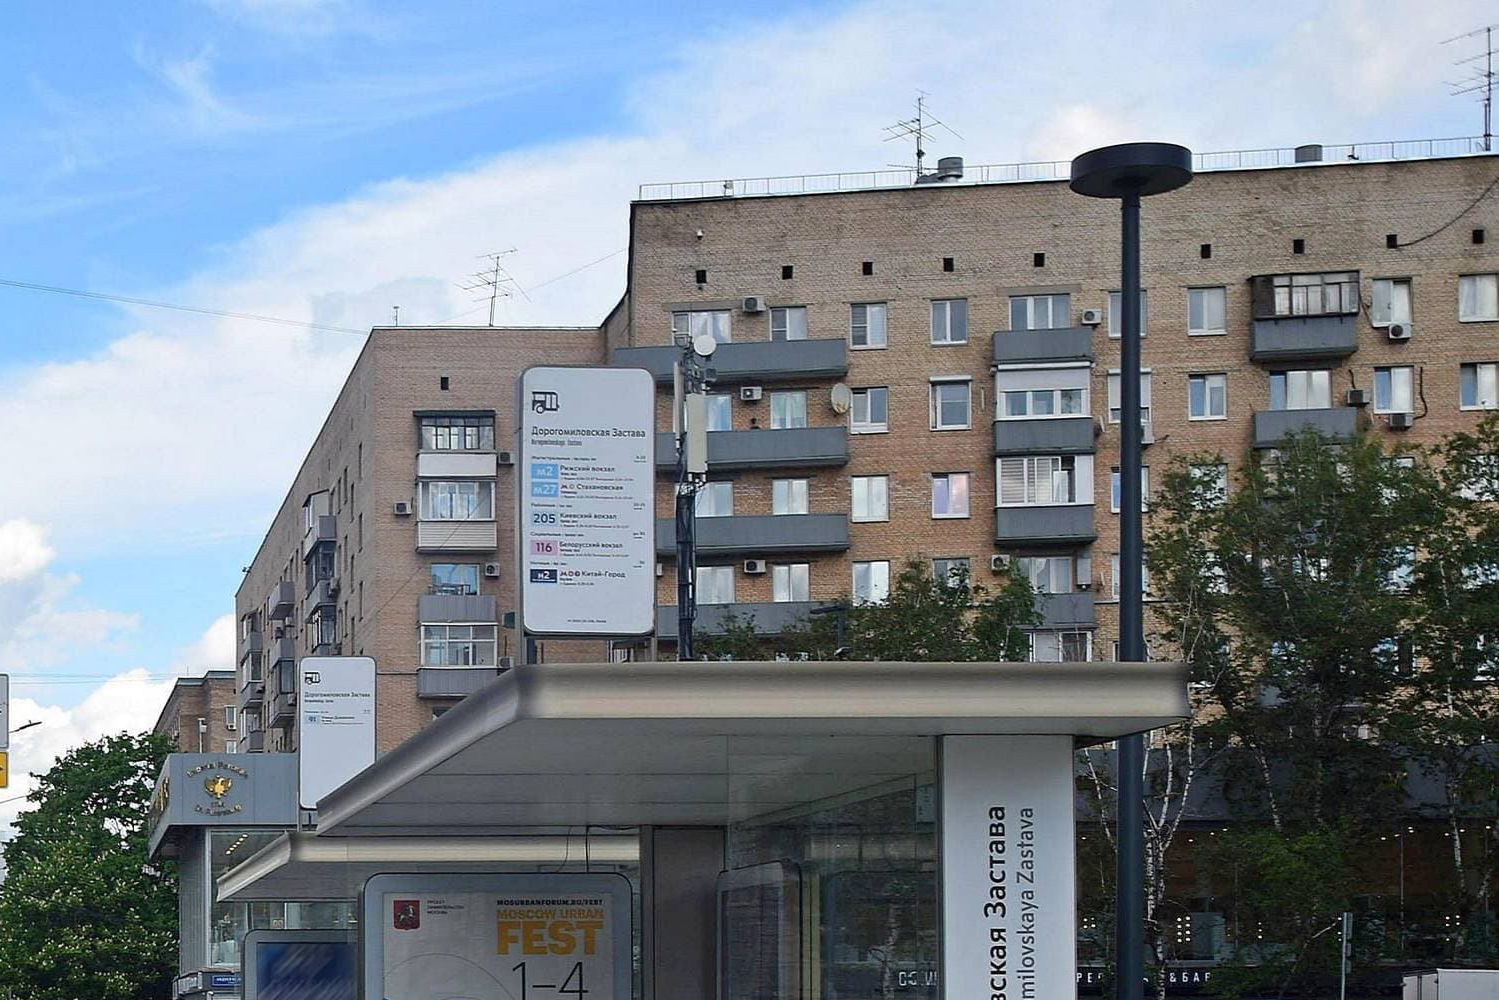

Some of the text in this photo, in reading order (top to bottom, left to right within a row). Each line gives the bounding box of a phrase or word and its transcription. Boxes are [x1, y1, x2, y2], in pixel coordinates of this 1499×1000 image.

[531, 426, 646, 437] Дорогомиловская Застава
[533, 513, 555, 523] 205
[536, 543, 552, 552] 116
[559, 541, 600, 549] Белорусский
[1017, 807, 1035, 883] Zastava
[984, 805, 1006, 918] Застава
[496, 909, 604, 919] MOSCOW URBAN
[496, 920, 603, 956] FEST
